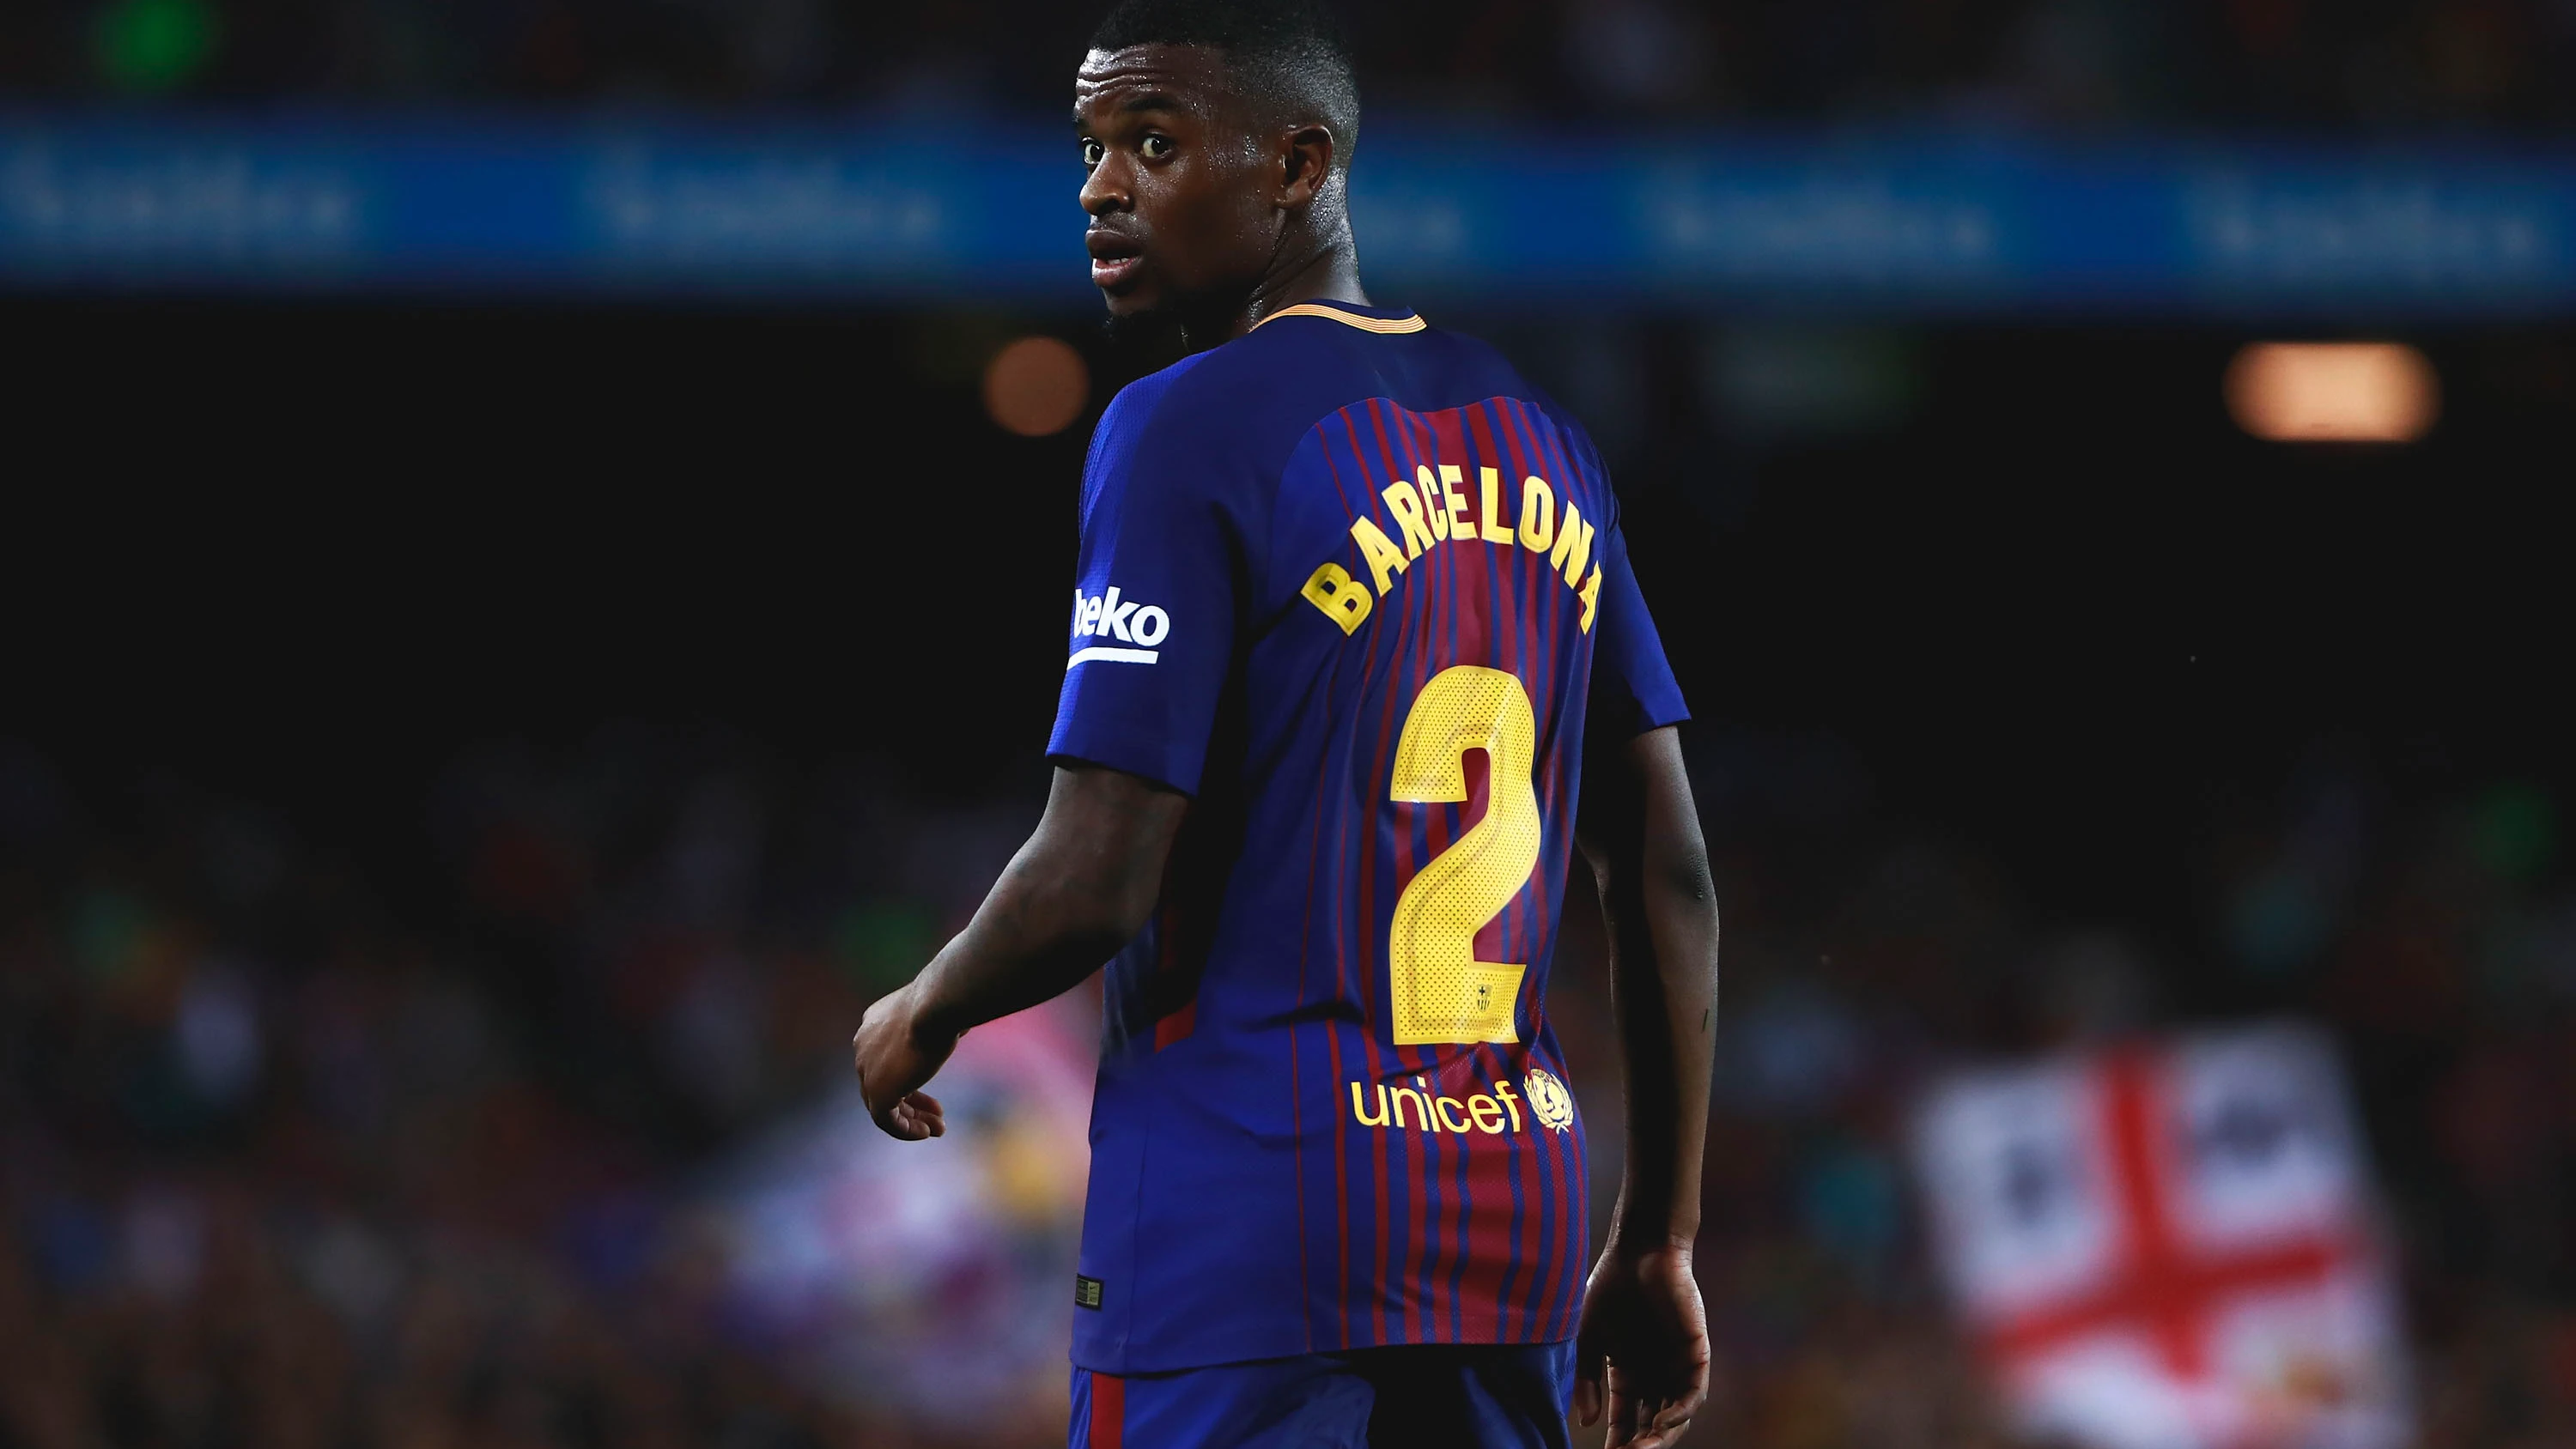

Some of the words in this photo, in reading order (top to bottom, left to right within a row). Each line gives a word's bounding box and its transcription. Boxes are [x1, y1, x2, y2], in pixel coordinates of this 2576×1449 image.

[1300, 464, 1602, 637] BARCELONA
[1073, 586, 1170, 646] beko
[1388, 664, 1542, 1046] 2
[1351, 1075, 1521, 1135] unicef
